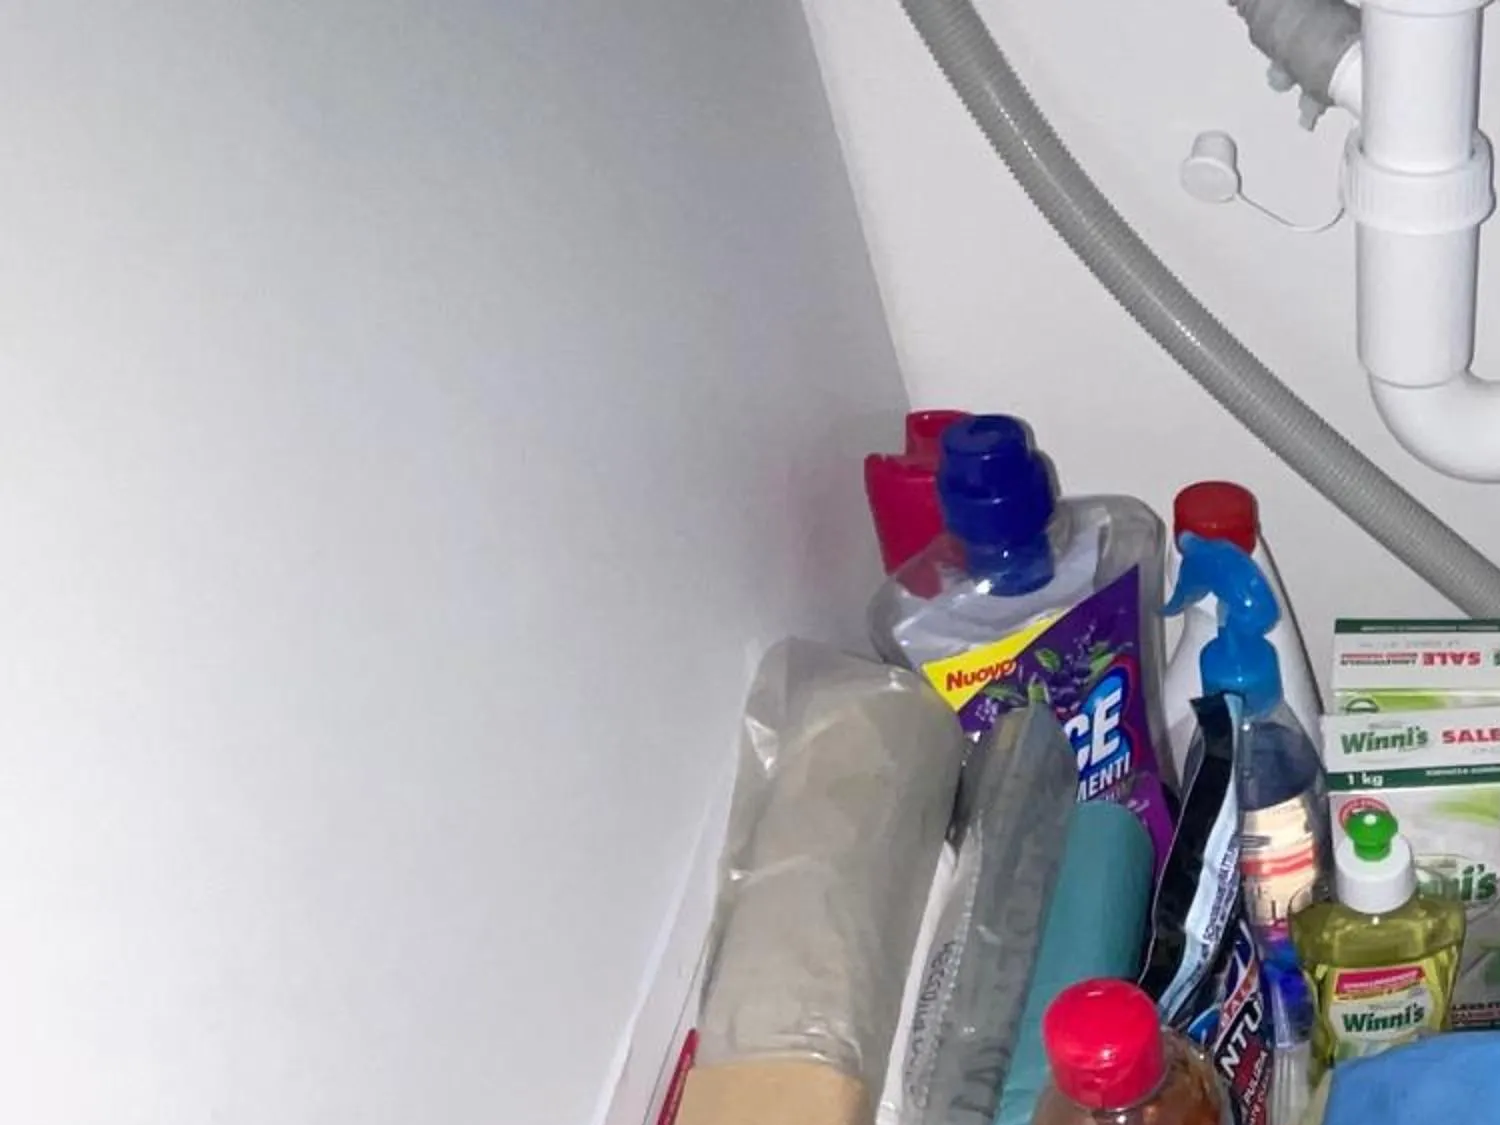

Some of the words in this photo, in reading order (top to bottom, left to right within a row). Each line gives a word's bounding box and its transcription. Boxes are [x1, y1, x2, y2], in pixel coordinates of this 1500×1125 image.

[946, 657, 1017, 691] Nuovo
[1423, 651, 1481, 666] SALE
[1064, 687, 1123, 773] CE
[1340, 725, 1429, 754] Winni's
[1342, 1002, 1425, 1033] Winni's
